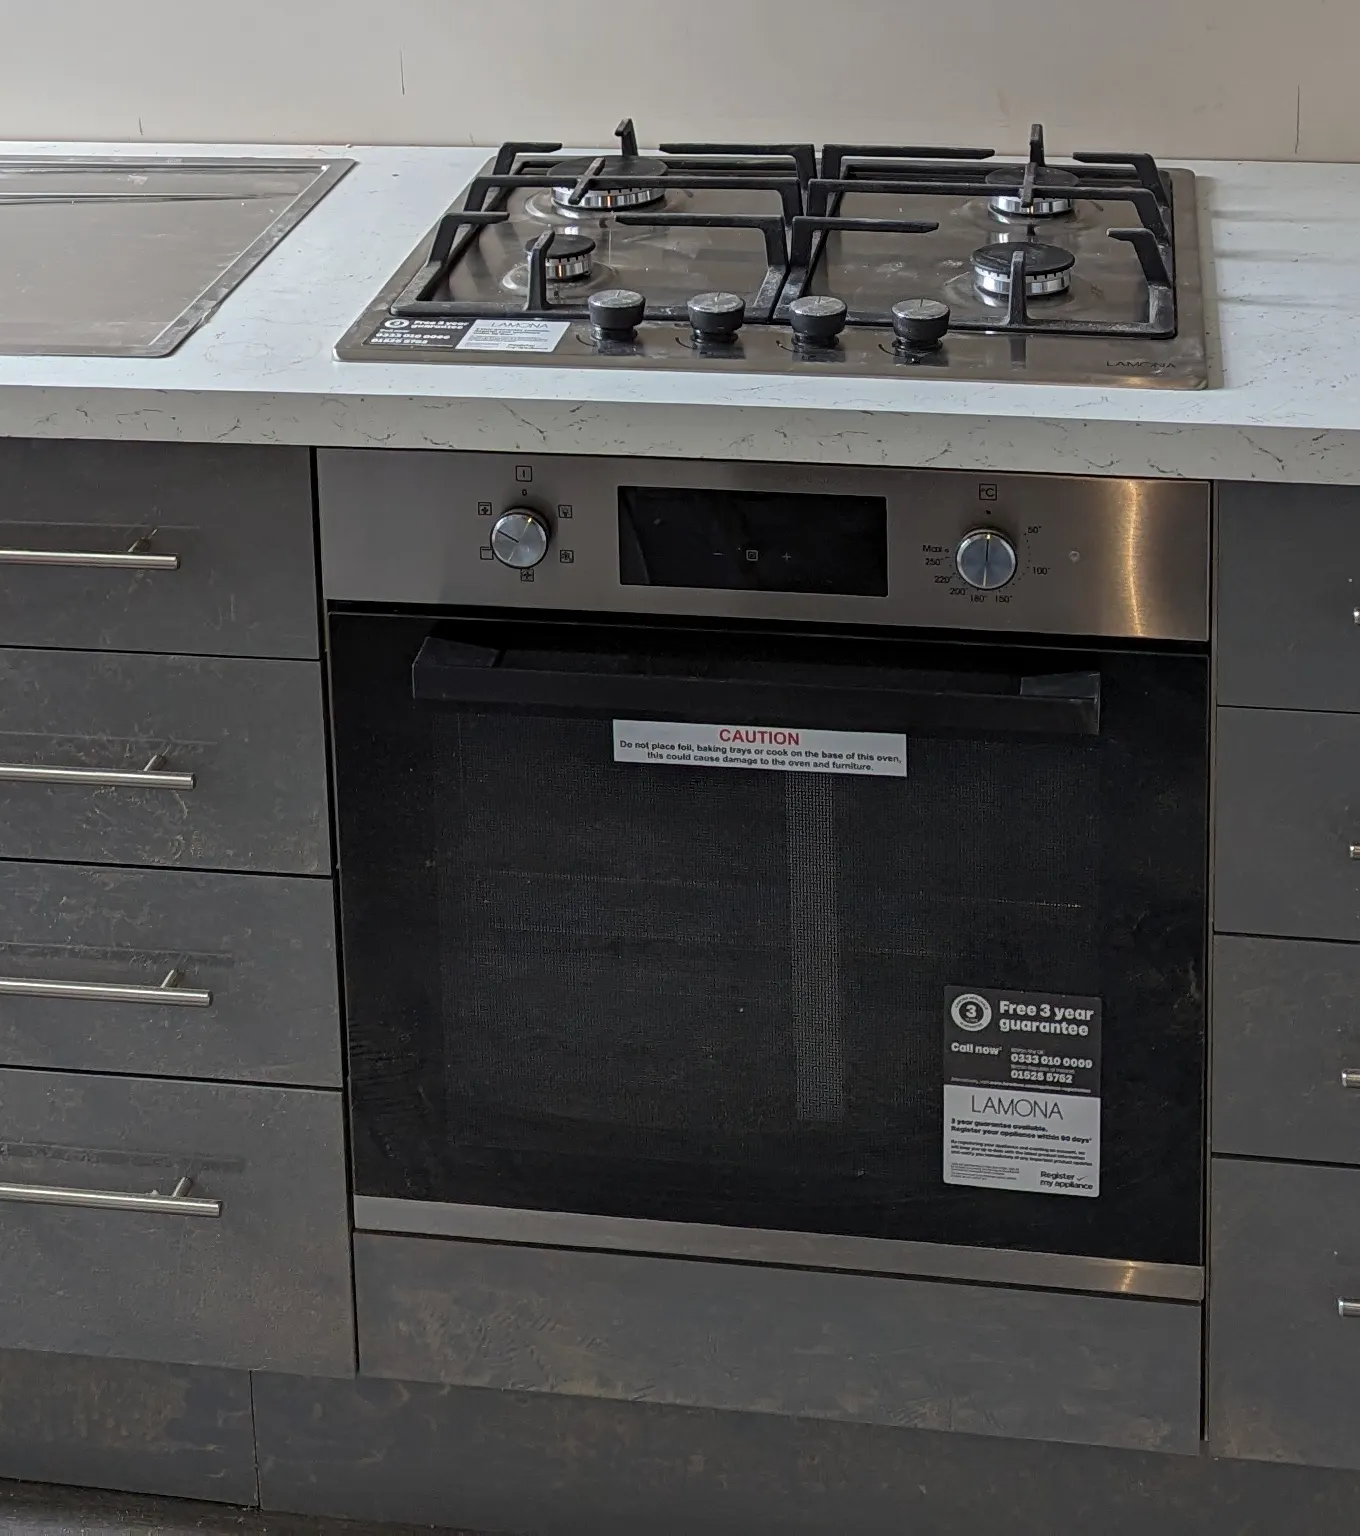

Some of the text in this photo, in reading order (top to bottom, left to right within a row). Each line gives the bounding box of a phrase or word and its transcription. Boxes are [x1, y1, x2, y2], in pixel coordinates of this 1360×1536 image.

[719, 729, 800, 745] CAUTION
[619, 740, 633, 749] Do
[634, 742, 649, 750] not
[651, 742, 676, 751] place
[677, 743, 695, 752] foil,
[696, 744, 727, 754] baking
[729, 746, 752, 755] trays
[804, 750, 819, 758] the
[821, 751, 844, 760] base
[845, 752, 856, 760] of
[857, 753, 875, 761] this
[647, 751, 874, 771] this could cause damage to the oven and furniture.
[965, 1004, 977, 1018] 3
[998, 1000, 1038, 1017] Free
[1039, 1004, 1051, 1018] 3
[1053, 1007, 1095, 1021] year
[998, 1018, 1089, 1036] guarantee
[951, 1042, 974, 1054] Call
[971, 1095, 1064, 1121] LAMONA
[1040, 1170, 1076, 1182] Register
[1039, 1179, 1094, 1191] my appliance
